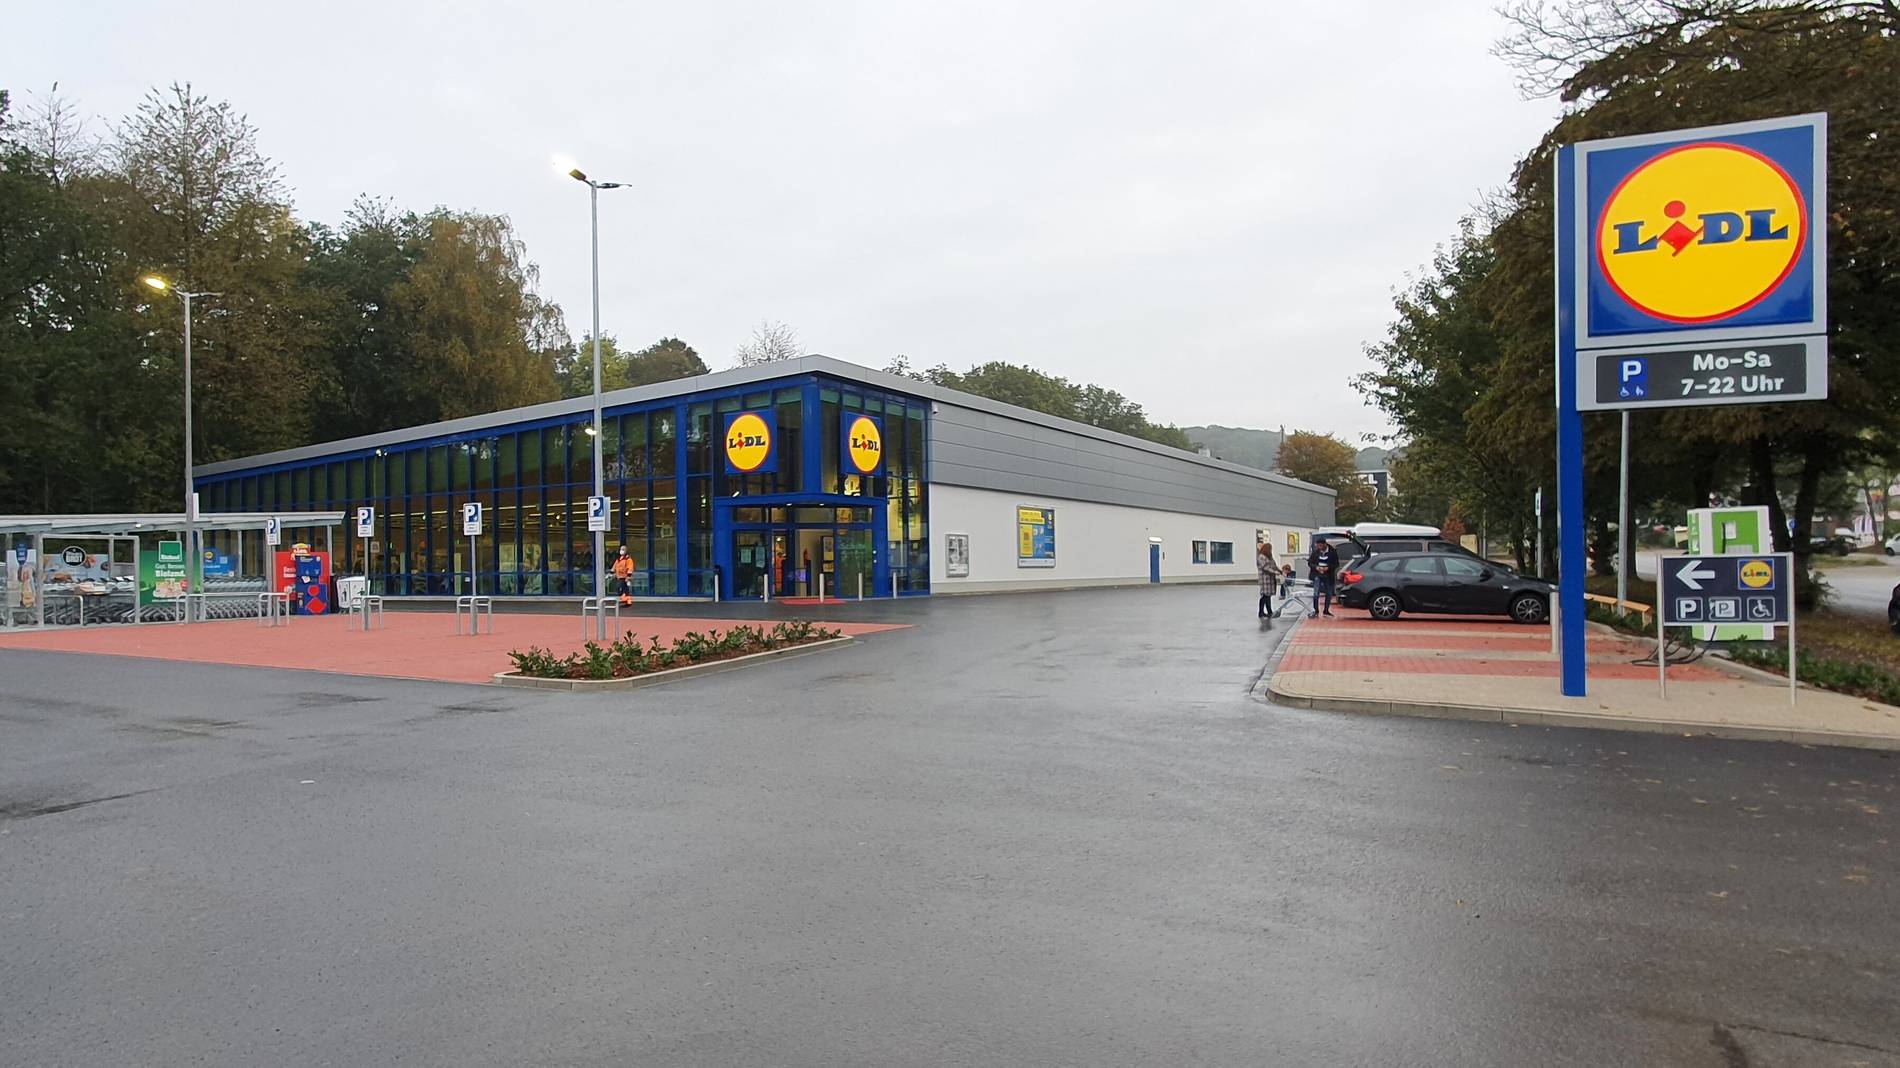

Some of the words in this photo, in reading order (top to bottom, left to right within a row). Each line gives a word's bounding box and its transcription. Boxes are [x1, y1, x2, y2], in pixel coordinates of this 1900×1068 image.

[1692, 350, 1772, 371] Mo-Sa
[1622, 360, 1642, 382] P
[1681, 378, 1735, 396] 7-22
[1741, 375, 1785, 393] Uhr
[465, 505, 476, 522] P
[590, 498, 601, 516] P
[359, 509, 369, 525] P
[267, 519, 275, 534] P
[1680, 600, 1697, 619] P
